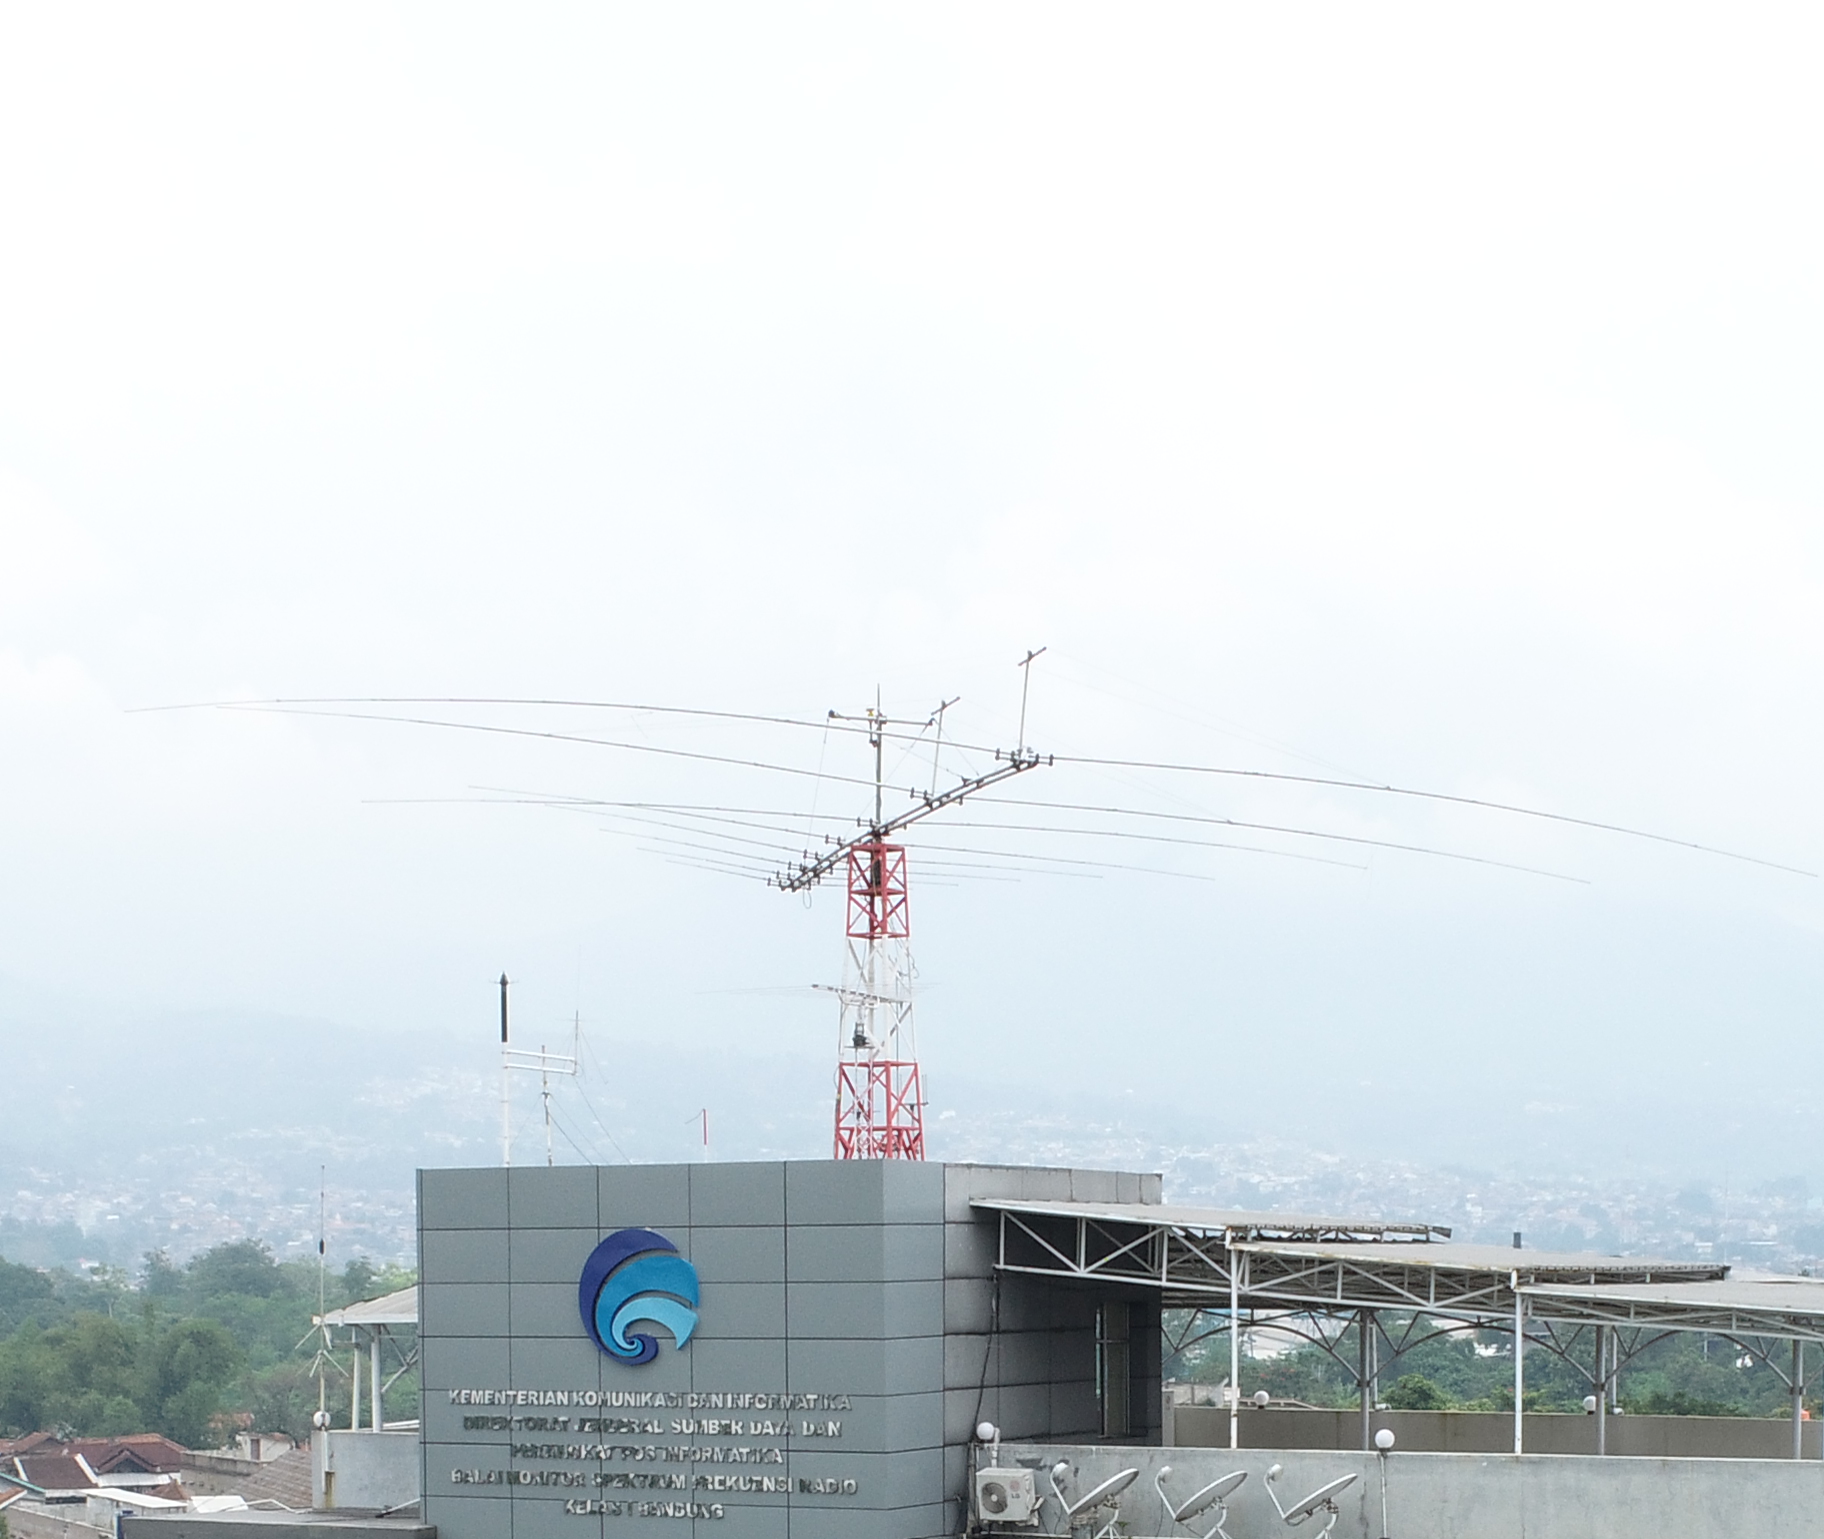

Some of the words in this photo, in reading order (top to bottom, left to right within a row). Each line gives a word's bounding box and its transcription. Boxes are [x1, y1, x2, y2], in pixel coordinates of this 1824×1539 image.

[449, 1389, 568, 1406] KEMENTERIAN
[572, 1390, 683, 1409] KOMUNIKASI
[687, 1393, 723, 1410] DAN
[726, 1393, 852, 1411] INFORMATIKA
[463, 1415, 571, 1432] DIREKTORAT
[574, 1417, 665, 1434] JENDERAL
[670, 1418, 744, 1436] SUMBER
[749, 1420, 796, 1436] DAYA
[802, 1421, 843, 1437] DAN
[620, 1445, 656, 1462] POS
[662, 1446, 785, 1464] INFORMATIKA
[451, 1469, 503, 1486] BALAI
[507, 1470, 586, 1488] MONITOR
[591, 1472, 687, 1490] SPEKTRUM
[691, 1474, 794, 1494] FREKUENSI
[798, 1477, 859, 1495] RADIO
[565, 1500, 623, 1516] KELAS
[637, 1501, 724, 1519] BANDUNG
